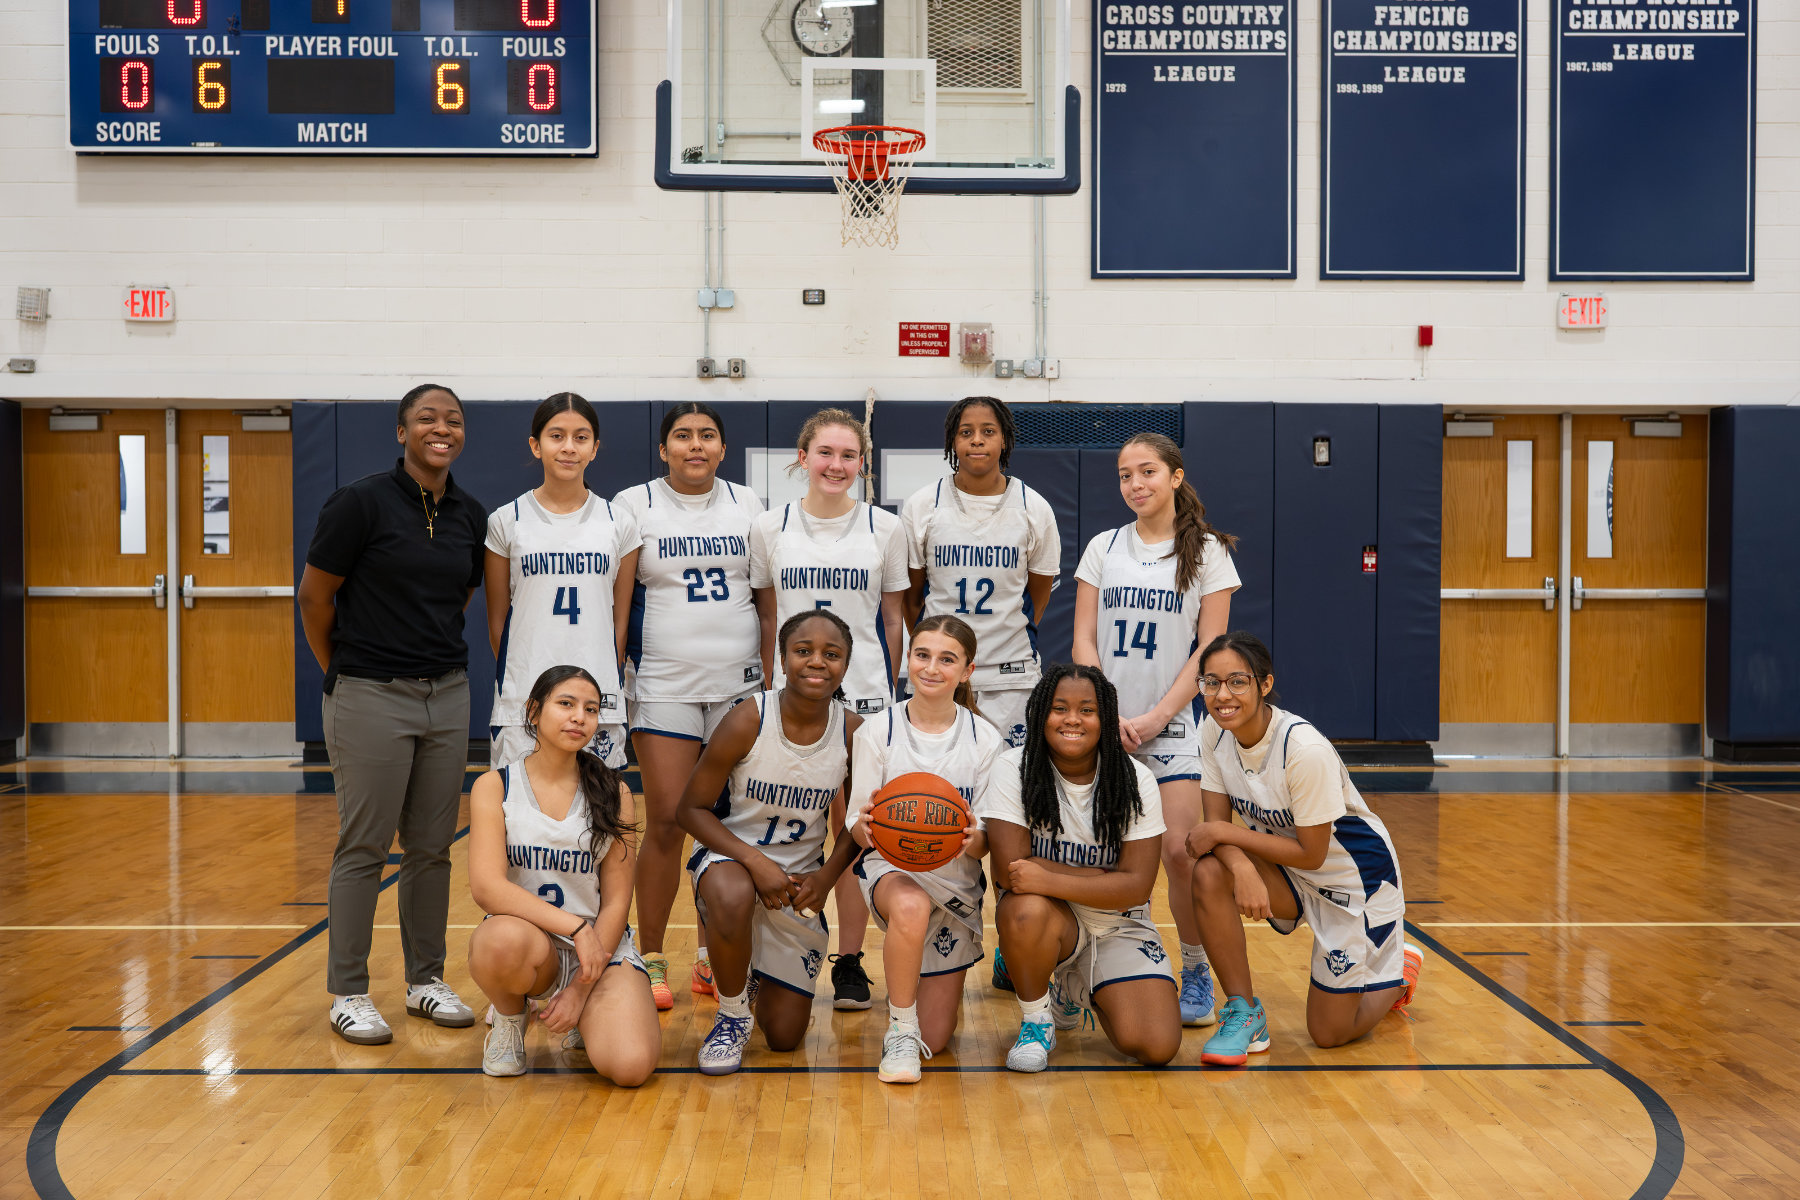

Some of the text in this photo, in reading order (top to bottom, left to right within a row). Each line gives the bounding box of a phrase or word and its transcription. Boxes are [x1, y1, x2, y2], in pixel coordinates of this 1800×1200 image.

[1106, 5, 1284, 25] CROSS COUNTRY
[1374, 6, 1469, 26] FENCING
[1568, 10, 1740, 30] CHAMPIONSHIP
[95, 34, 160, 55] FOULS
[185, 36, 240, 55] T.O.L.
[265, 36, 398, 56] PLAYER FOUL
[424, 37, 478, 56] T.O.L.
[502, 37, 566, 56] FOULS
[1103, 30, 1287, 50] CHAMPIONSHIPS
[1333, 30, 1517, 51] CHAMPIONSHIPS
[1613, 44, 1695, 60] LEAGUE
[1154, 66, 1236, 82] LEAGUE
[1384, 66, 1466, 83] LEAGUE
[1592, 62, 1613, 72] 1969
[121, 62, 149, 109] 0
[199, 62, 225, 109] 6
[437, 63, 464, 110] 6
[528, 64, 555, 110] 0
[1105, 83, 1127, 93] 1978
[1336, 84, 1383, 94] 1998, 1999
[96, 122, 161, 142] SCORE
[297, 123, 367, 142] MATCH
[501, 124, 565, 143] SCORE
[130, 290, 166, 318] EXIT
[1567, 297, 1603, 325] EXIT
[658, 535, 746, 559] HUNTINGTON
[934, 545, 1020, 569] HUNTINGTON
[521, 552, 610, 577] HUNTINGTON
[683, 567, 730, 602] 23
[781, 567, 869, 591] HUNTINGTON
[552, 586, 581, 625] 4
[955, 577, 995, 615] 12
[1103, 586, 1184, 614] HUNTINGTON
[1113, 619, 1158, 660] 14
[746, 777, 838, 811] HUNTINGTON
[886, 800, 918, 823] THE
[757, 815, 807, 846] 13
